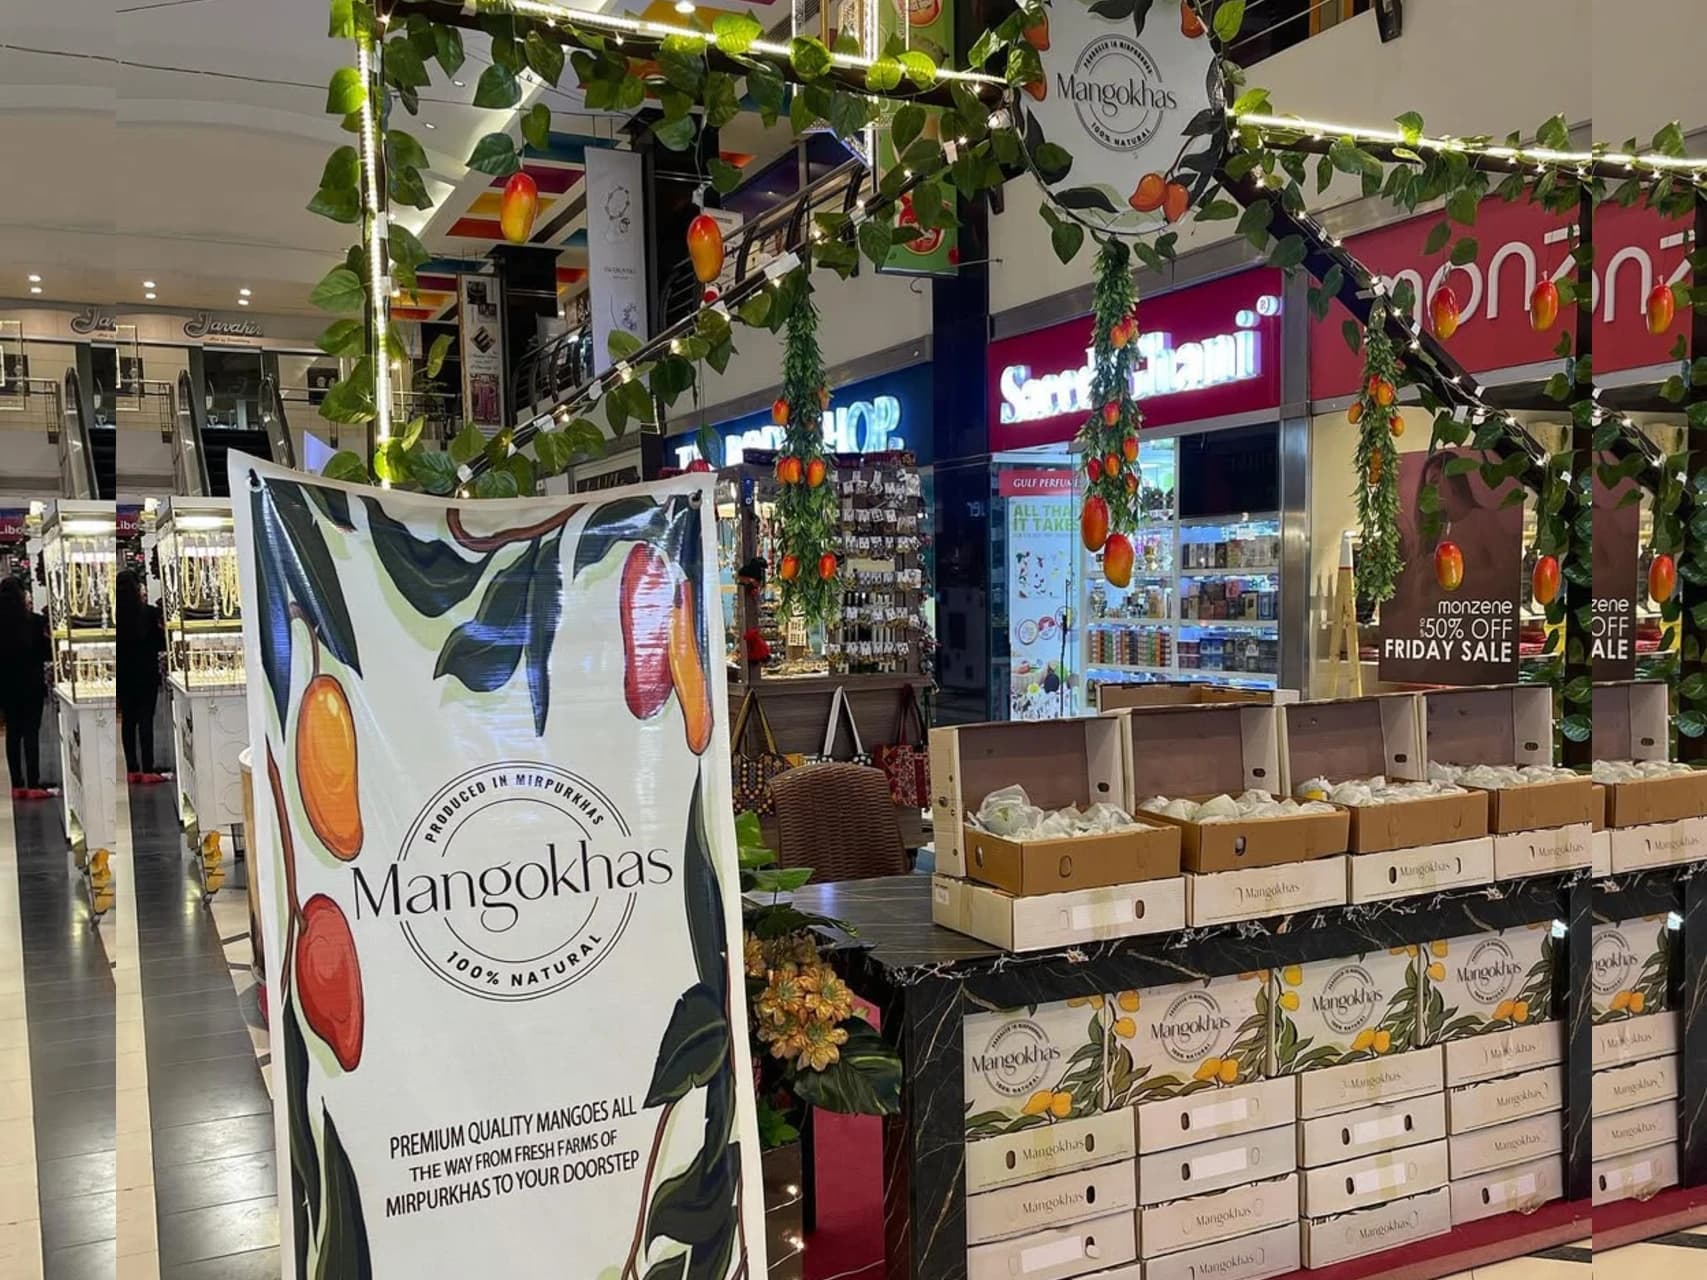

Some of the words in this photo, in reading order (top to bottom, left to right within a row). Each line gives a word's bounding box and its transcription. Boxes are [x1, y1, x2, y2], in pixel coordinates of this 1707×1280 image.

[1056, 72, 1178, 118] Mangokhas
[1012, 478, 1036, 489] GULF
[1014, 504, 1040, 517] ALL
[1014, 518, 1027, 532] IT
[1438, 600, 1513, 615] monzene
[1424, 617, 1465, 639] 50%
[1471, 617, 1513, 640] OFF
[1384, 639, 1455, 660] FRIDAY
[1460, 640, 1512, 663] SALE
[424, 782, 486, 844] PRODUCED
[492, 775, 509, 789] IN
[515, 773, 604, 826] MIRPURKHAS
[350, 839, 674, 933] Mangokhas
[446, 950, 500, 986] 100%
[510, 933, 602, 988] NATURAL
[1151, 1014, 1231, 1043] Mangokhas
[971, 1044, 1062, 1077] Mangokhas
[389, 1125, 465, 1160] PREMIUM
[468, 1113, 534, 1144] QUALITY
[536, 1100, 609, 1133] MANGOES
[611, 1095, 637, 1119] ALL
[409, 1163, 441, 1183] THE
[444, 1155, 474, 1177] WAY
[475, 1147, 513, 1171] FROM
[514, 1142, 556, 1164] FRESH
[557, 1132, 599, 1157] FARMS
[600, 1128, 618, 1148] OF
[385, 1178, 491, 1218] MIRPURKHAS
[492, 1173, 513, 1196] TO
[515, 1165, 560, 1190] YOUR
[562, 1149, 640, 1184] DOORSTEP
